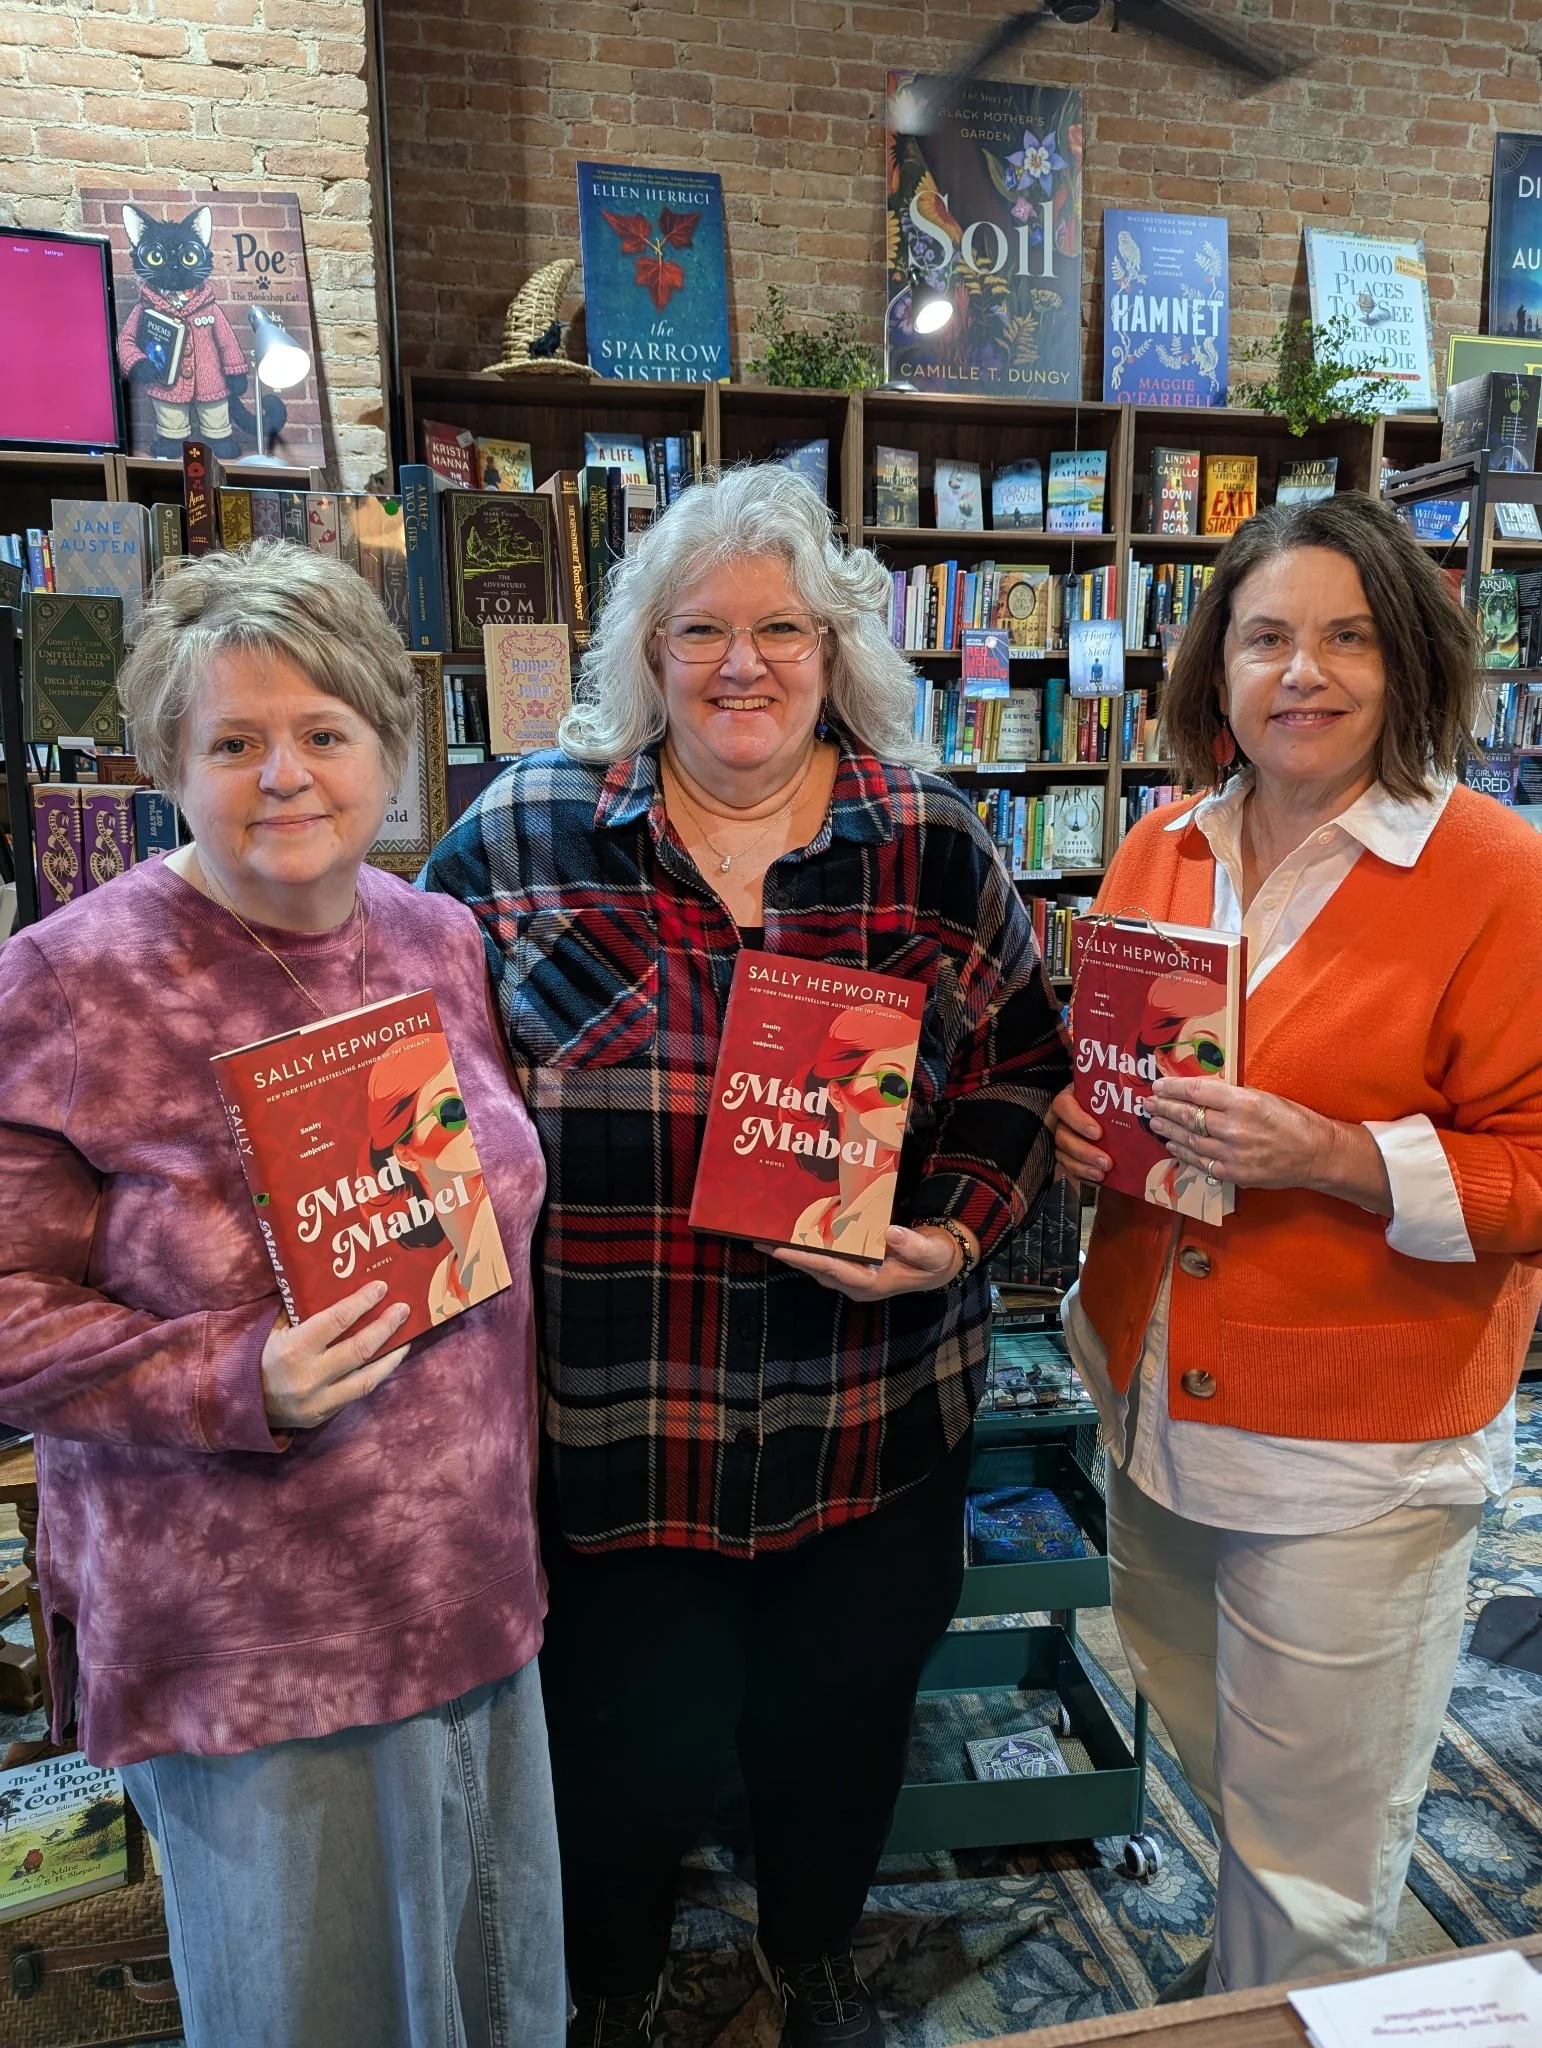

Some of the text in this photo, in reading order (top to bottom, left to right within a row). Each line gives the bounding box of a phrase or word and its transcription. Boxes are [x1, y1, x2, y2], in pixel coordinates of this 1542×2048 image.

[938, 108, 1045, 127] BLACK MOTHER'S
[960, 128, 1011, 142] GARDEN
[593, 184, 640, 200] ELLEN
[907, 190, 1060, 279] Soil
[232, 233, 287, 274] Poe
[1339, 250, 1393, 275] 1,000
[1334, 273, 1404, 299] PLACES
[232, 291, 299, 304] The Bookshop Cat
[1112, 293, 1224, 337] HAMNET
[1378, 300, 1414, 323] SEE
[147, 320, 172, 338] POEMS
[650, 320, 674, 337] the
[601, 340, 721, 363] SPARROW
[1380, 346, 1416, 369] DIE
[612, 364, 712, 383] SISTERS
[900, 363, 1071, 385] CAMILLE T. DUNGY
[1139, 377, 1196, 391] MAGGIE
[500, 447, 527, 466] Right
[599, 448, 634, 462] A LIFE
[1165, 454, 1191, 465] LINDA
[1157, 466, 1199, 478] CASTILLO
[1212, 462, 1255, 473] LEE CHILD
[1291, 461, 1326, 475] DAVID
[450, 472, 462, 481] THE
[1280, 473, 1336, 488] BALDACCI
[511, 481, 530, 492] Man
[998, 485, 1036, 496] GOOD
[1161, 488, 1192, 500] DOWN
[418, 494, 429, 519] TALE
[599, 486, 608, 513] ANNE
[999, 494, 1036, 504] TOWN
[1211, 491, 1255, 517] EXIT
[405, 486, 419, 550] TWO CITIES
[590, 485, 600, 548] GREEN GABLES
[1163, 510, 1189, 521] DARK
[1415, 508, 1451, 522] William
[1502, 508, 1534, 524] LEIGH
[73, 520, 121, 535] JANE
[1162, 523, 1189, 534] ROAD
[1417, 518, 1443, 530] Woolf
[1506, 522, 1538, 533] BARDUGO
[60, 538, 135, 554] AUSTEN
[80, 586, 120, 595] SENSE
[572, 563, 584, 620] Tom Sawyer
[1479, 578, 1514, 592] ARNIA
[476, 597, 535, 613] TOM
[476, 613, 536, 624] SAWYER
[1079, 629, 1118, 643] Hearts
[39, 650, 75, 659] UNITED
[966, 646, 988, 657] RED
[1009, 650, 1041, 658] STORY
[1084, 645, 1112, 657] Steel
[61, 659, 104, 667] AMERICA
[512, 659, 556, 673] Romeo
[966, 657, 999, 667] MOON
[966, 667, 1008, 678] RISING
[44, 677, 106, 686] DECLARATION
[1078, 684, 1118, 692] CAMDEN
[48, 689, 104, 697] INDEPENDENCE
[517, 684, 552, 698] Juliet
[1493, 770, 1511, 778] WHO
[149, 799, 158, 837] TOLSTOY
[155, 810, 163, 827] LEO
[96, 813, 116, 850] ALEXANDRE
[48, 812, 70, 849] ALEXANDRE
[67, 848, 78, 872] DUMAS
[1021, 871, 1055, 879] HISTORY
[1077, 937, 1212, 973] SALLY HEPWORTH
[1115, 964, 1208, 986] BESTSELLING AUTHOR SOULMATE
[748, 965, 909, 1009] SALLY HEPWORTH
[794, 995, 830, 1006] BESTSELLING
[830, 1002, 854, 1011] AUTHOR
[875, 1010, 902, 1020] SOULMATE
[762, 1022, 782, 1032] Sanity
[254, 1012, 431, 1089] SALLY HEPWORTH
[752, 1040, 785, 1051] subjective.
[1076, 1037, 1157, 1082] Mad
[266, 1037, 431, 1104] NEW YORK TIMES BESTSELLING AUTHOR OF THE SOULMATE
[721, 1071, 828, 1116] Mad
[229, 1104, 254, 1156] SALLY
[300, 1121, 322, 1136] Sanity
[1115, 1120, 1132, 1129] NOVEL
[311, 1135, 318, 1143] is
[733, 1116, 878, 1168] Mabel
[299, 1141, 335, 1160] subjective.
[765, 1160, 786, 1168] NOVEL
[296, 1155, 407, 1243] Mad
[332, 1174, 472, 1279] Mabel
[257, 1217, 285, 1272] Mad
[372, 1256, 393, 1270] NOVEL
[8, 1775, 37, 1787] The
[32, 1782, 48, 1794] at
[24, 1778, 117, 1811] Corner
[29, 1810, 54, 1820] Classic
[56, 1801, 82, 1812] Edition
[21, 1864, 79, 1886] A. A. Milne
[33, 1863, 101, 1891] by E. H. Shepard
